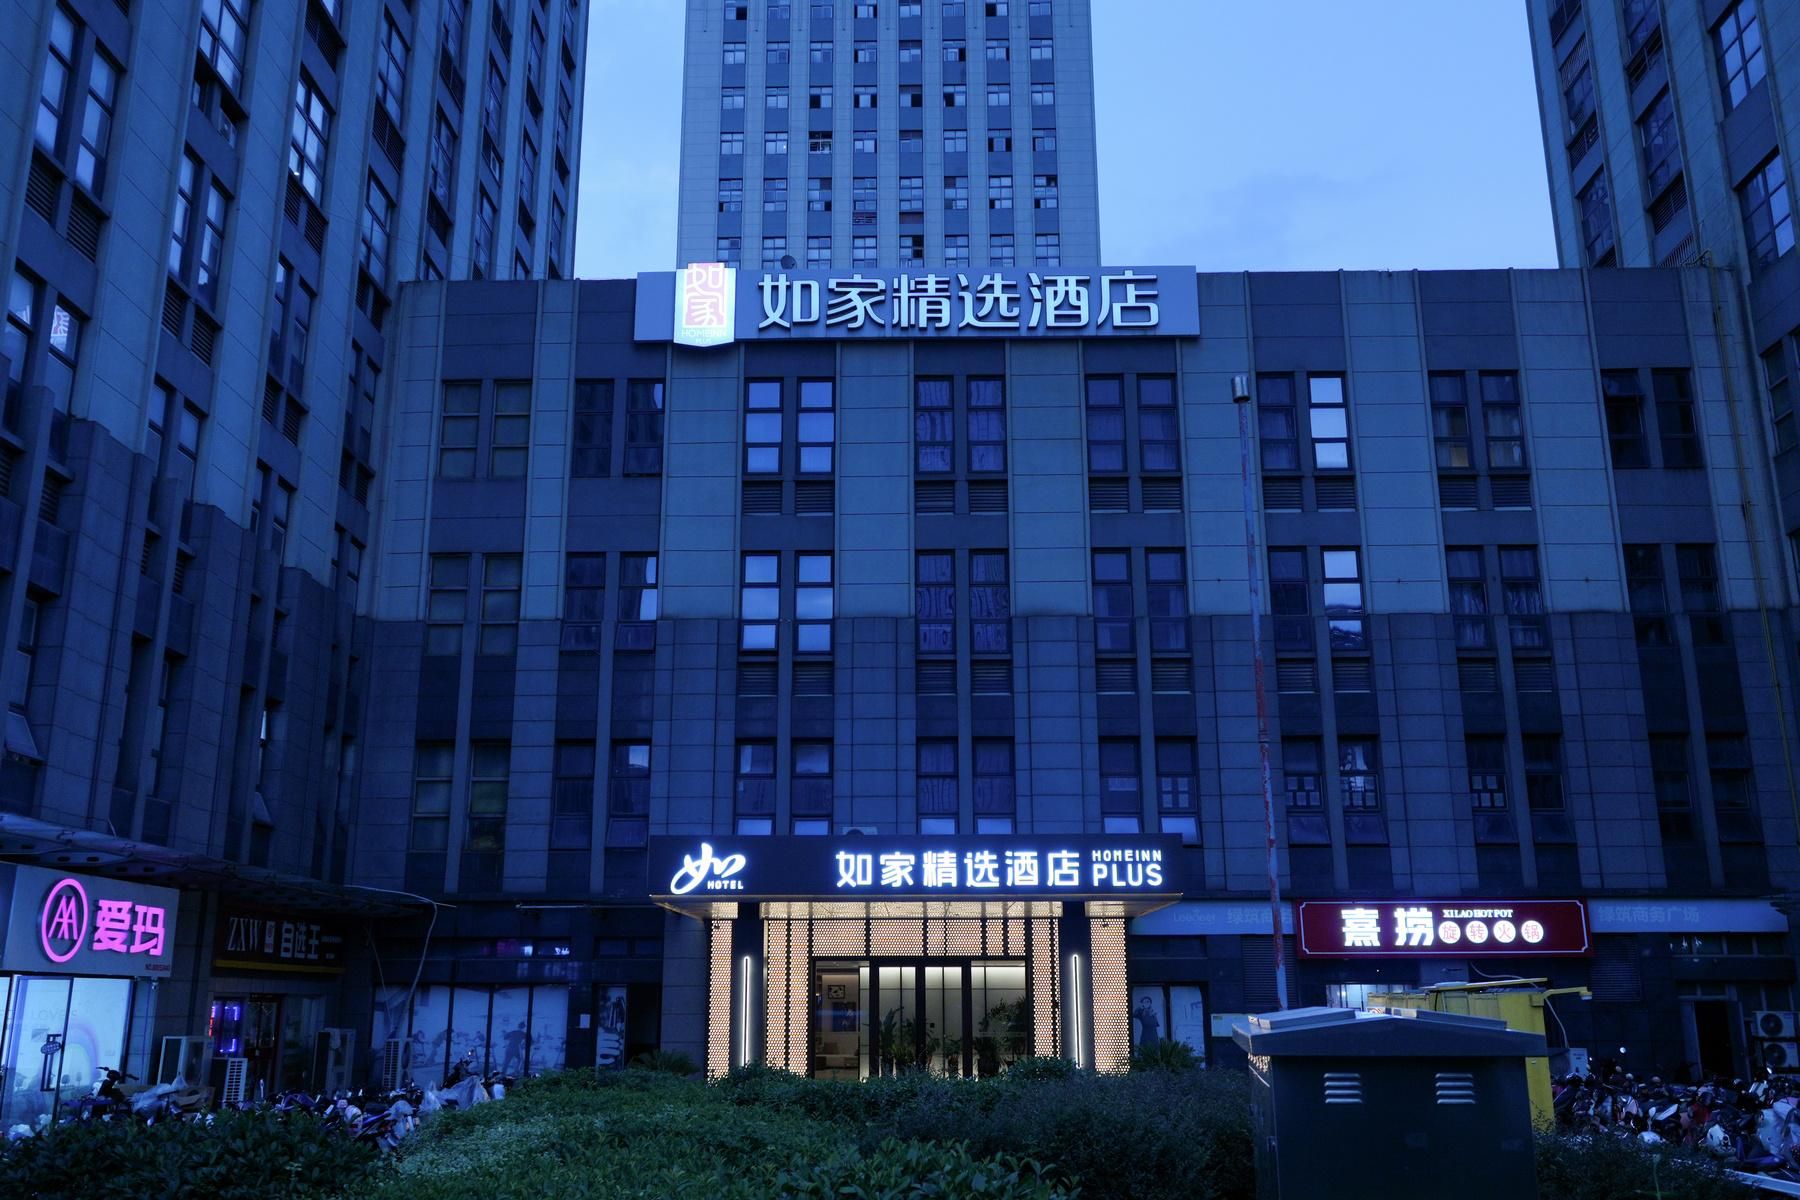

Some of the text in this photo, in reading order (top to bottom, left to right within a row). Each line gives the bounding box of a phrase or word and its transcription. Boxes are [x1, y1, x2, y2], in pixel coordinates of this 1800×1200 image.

[758, 270, 1159, 329] 如家精选酒店
[836, 850, 1080, 888] 如家精选酒店
[1092, 849, 1162, 862] HOMEINN
[707, 880, 744, 890] HOTEL
[1093, 863, 1163, 887] PLUS
[92, 899, 166, 957] 爱玛
[227, 917, 261, 952] ZXW
[1441, 922, 1541, 942] 旋转火锅
